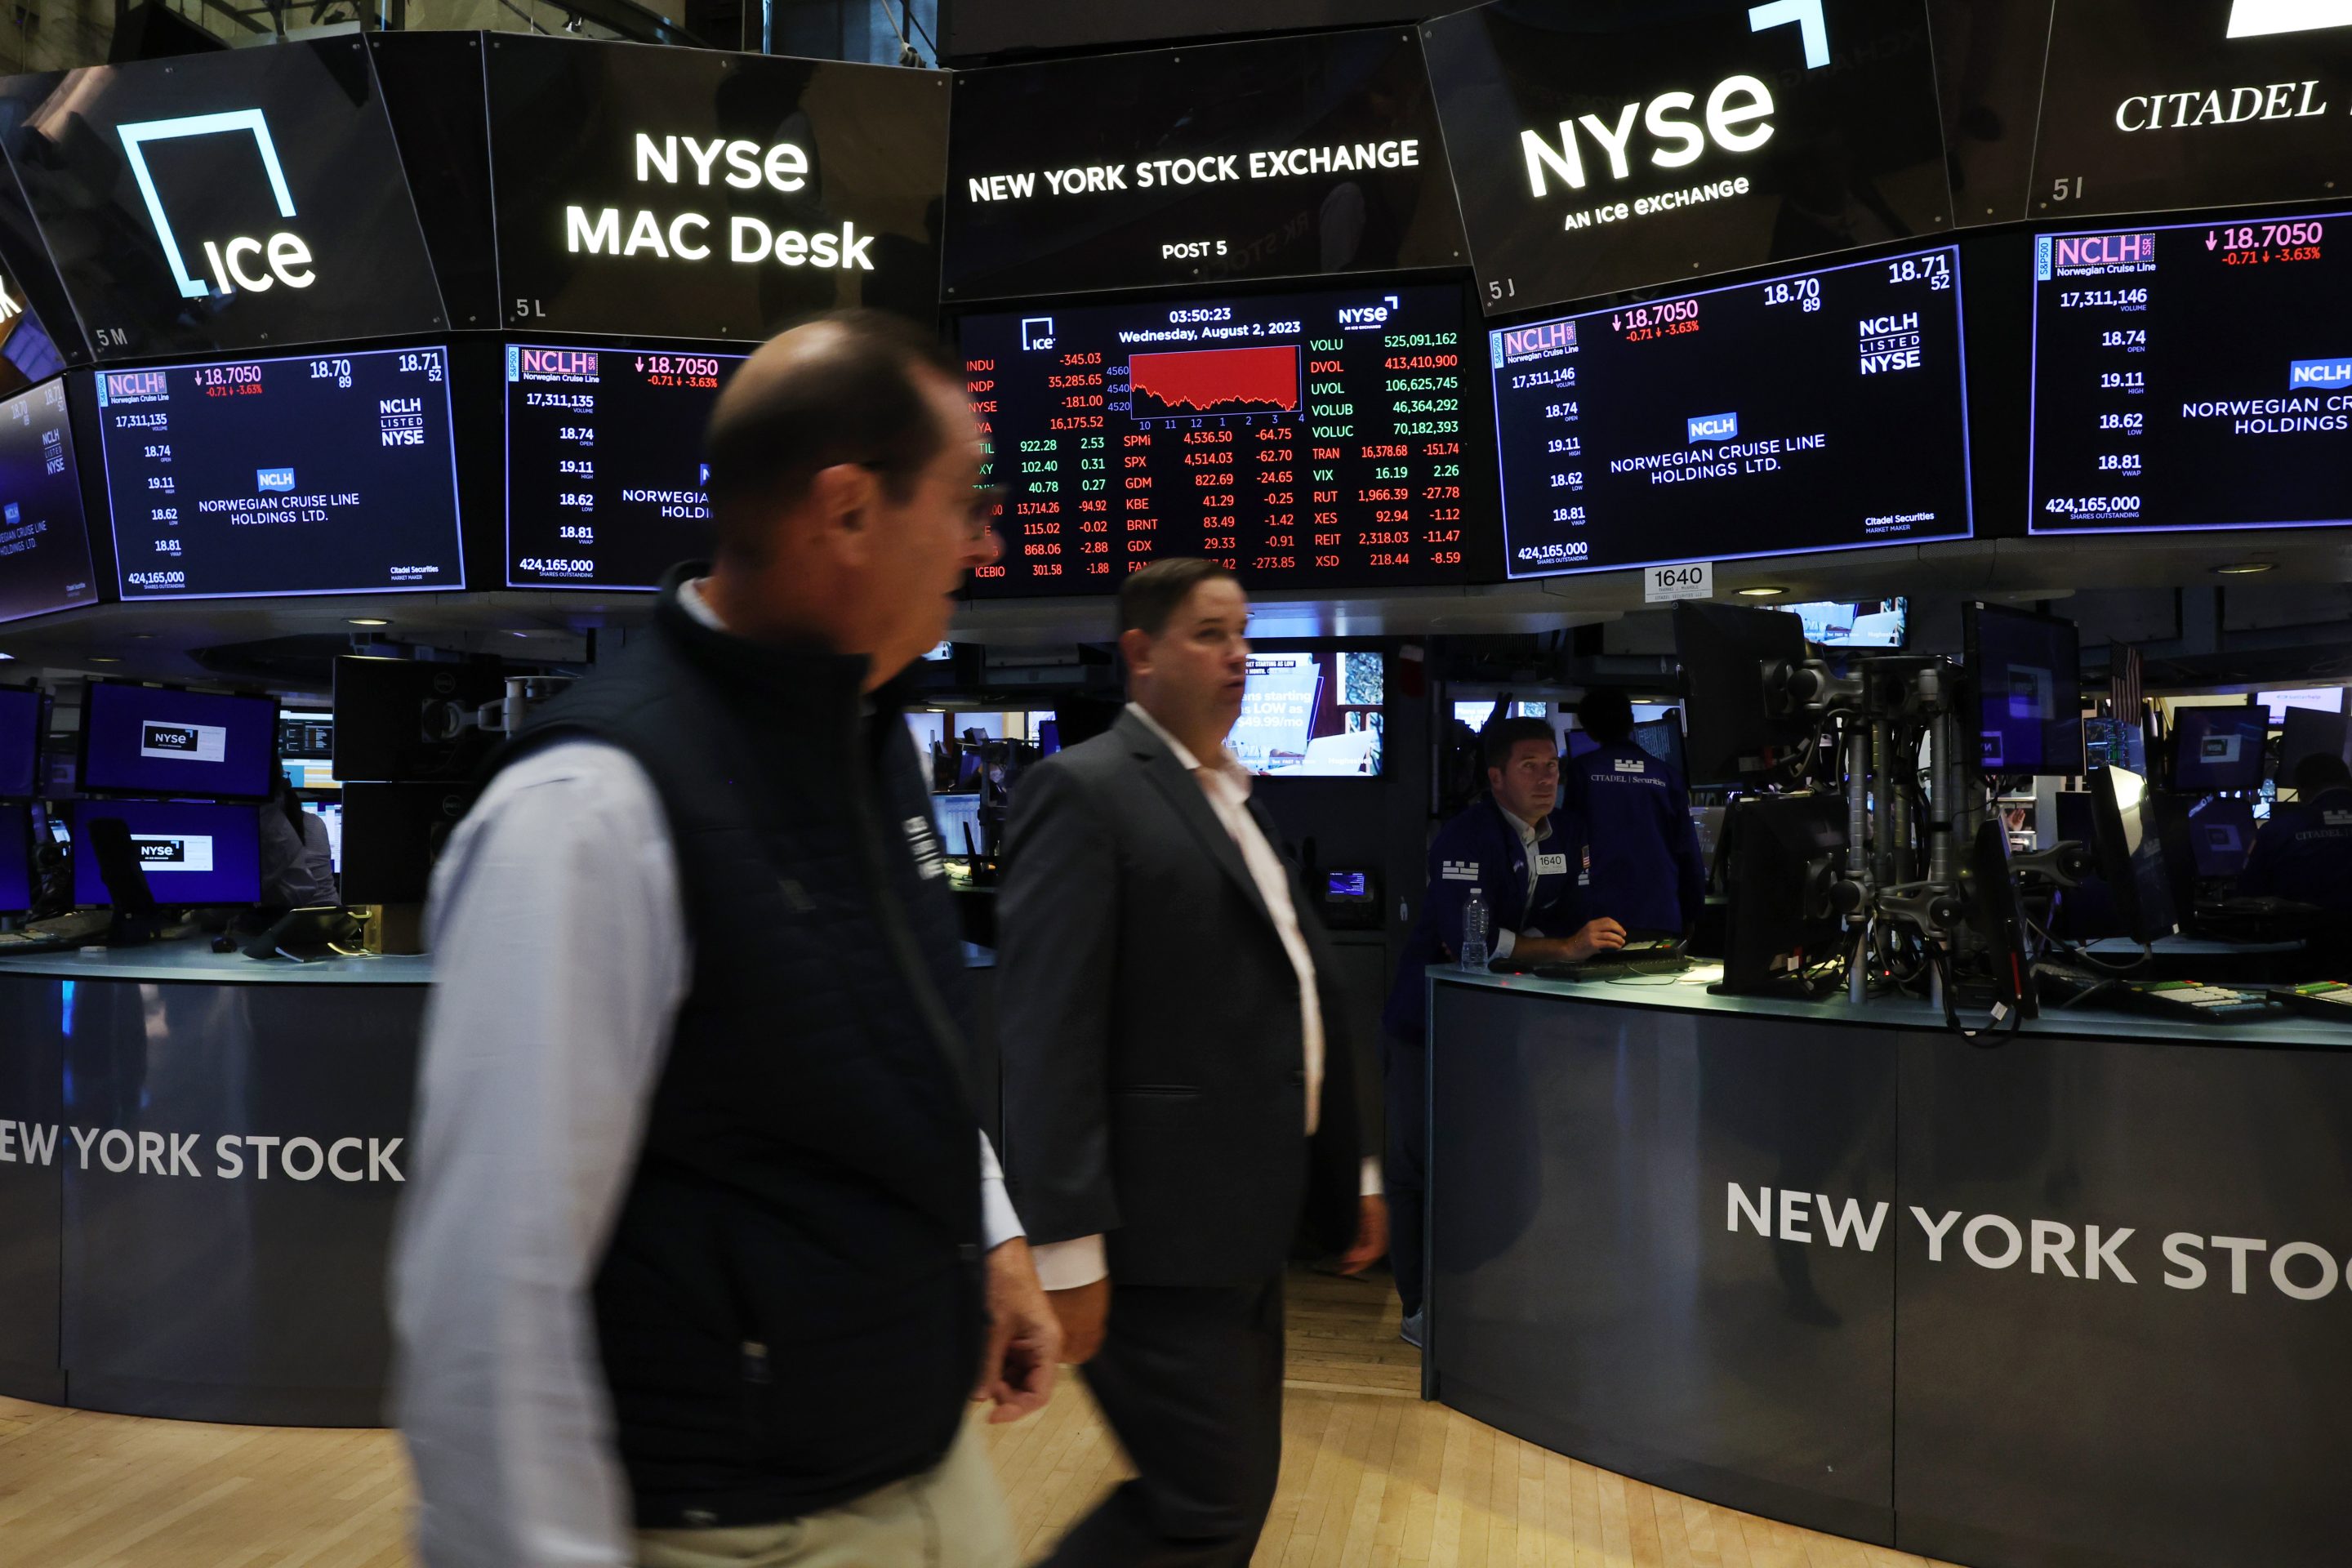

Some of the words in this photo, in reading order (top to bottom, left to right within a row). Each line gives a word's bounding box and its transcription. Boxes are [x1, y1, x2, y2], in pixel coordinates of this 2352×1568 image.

[2116, 81, 2327, 131] CITADEL
[969, 173, 1035, 202] NEW
[1044, 165, 1127, 194] YORK
[1137, 155, 1240, 187] STOCK
[1250, 140, 1419, 178] EXCHANGE
[2053, 178, 2069, 200] 5
[1565, 212, 1591, 230] AN
[567, 206, 710, 260] MAC
[731, 216, 875, 270] Desk
[2224, 222, 2322, 250] 18.7050
[1163, 242, 1210, 259] POST
[1217, 241, 1227, 255] 5
[2059, 234, 2141, 266] NCLH
[2222, 252, 2257, 265] -0.71
[2275, 247, 2320, 261] -3.63%
[1888, 256, 1950, 283] 18.71
[2057, 265, 2105, 276] Norwegian
[2107, 265, 2135, 274] Cruise
[2137, 263, 2156, 271] Line
[1490, 281, 1502, 299] 5
[1508, 278, 1514, 296] J
[1931, 274, 1949, 290] 52
[1764, 278, 1821, 305] 18.70
[2060, 288, 2147, 308] 17,311,146
[517, 299, 528, 316] 5
[536, 300, 546, 317] L
[1625, 300, 1699, 328] 18.7050
[1803, 298, 1821, 312] 89
[1169, 308, 1231, 323] 03:50:23
[1860, 312, 1918, 336] NCLH
[96, 330, 109, 345] 5
[110, 328, 127, 345] M
[1119, 328, 1197, 343] Wednesday,
[1201, 325, 1249, 339] August
[1253, 323, 1264, 336] 2,
[1268, 321, 1300, 334] 2023
[1627, 328, 1653, 341] -0.71
[1665, 320, 1699, 335] -3.63%
[2102, 330, 2146, 345] 18.74
[1310, 339, 1343, 351] VOLU
[1385, 332, 1456, 347] 525,091,162
[1507, 323, 1566, 357] NCLH
[1860, 334, 1920, 354] LISTED
[310, 359, 352, 378] 18.70
[399, 353, 441, 372] 18.71
[522, 350, 589, 374] NCLH
[648, 357, 718, 376] 18.7050
[967, 359, 994, 371] INDU
[1060, 353, 1101, 365] -345.03
[1311, 361, 1343, 372] DVOL
[1385, 354, 1457, 369] 413,410,900
[1860, 350, 1921, 374] NYSE
[205, 366, 261, 385] 18.7050
[1512, 368, 1575, 389] 17,311,146
[2101, 372, 2145, 387] 19.11
[2294, 365, 2352, 382] NCLH
[109, 372, 160, 395] NCLH
[968, 381, 994, 392] INDP
[1049, 374, 1102, 388] 35,285.65
[1312, 382, 1344, 394] UVOL
[1386, 377, 1458, 391] 106,625,745
[380, 398, 421, 413] NCLH
[527, 393, 594, 408] 17,311,135
[2183, 398, 2319, 417] NORWEGIAN
[1546, 402, 1578, 418] 18.74
[116, 413, 167, 428] 17,311,135
[381, 417, 422, 427] LISTED
[1051, 416, 1103, 430] 16,175.52
[1312, 425, 1353, 438] VOLUC
[1394, 421, 1458, 435] 70,182,393
[1688, 418, 1734, 435] NCLH
[2235, 415, 2348, 434] HOLDINGS
[382, 430, 424, 446] NYSE
[560, 428, 594, 439] 18.74
[1124, 434, 1151, 447] SPMi
[1184, 431, 1232, 444] 4,536.50
[1255, 428, 1292, 440] -64.75
[145, 445, 171, 457] 18.74
[1021, 439, 1057, 452] 922.28
[1081, 437, 1104, 448] 2.53
[1312, 448, 1339, 459] TRAN
[1362, 445, 1408, 458] 16,378.68
[1423, 443, 1459, 455] -151.74
[1548, 437, 1580, 452] 19.11
[1611, 448, 1715, 474] NORWEGIAN
[1719, 440, 1780, 459] CRUISE
[1786, 434, 1825, 451] LINE
[560, 461, 594, 473] 19.11
[1022, 461, 1058, 472] 102.40
[1081, 458, 1105, 470] 0.31
[1313, 470, 1333, 481] VIX
[1376, 467, 1407, 479] 16.19
[1434, 465, 1459, 476] 2.26
[1651, 461, 1737, 484] HOLDINGS
[1746, 458, 1780, 473] LTD.
[257, 474, 295, 487] NCLH
[1551, 472, 1583, 487] 18.62
[199, 497, 278, 512] NORWEGIAN
[282, 495, 327, 508] CRUISE
[331, 493, 359, 506] LINE
[623, 490, 708, 503] NORWEGIA
[1314, 491, 1338, 502] RUT
[1359, 488, 1408, 501] 1,966.39
[1423, 487, 1459, 498] -27.78
[2046, 497, 2140, 513] 424,165,000
[231, 511, 296, 525] HOLDINGS
[302, 510, 328, 522] LTD.
[1865, 515, 1894, 525] Citadel
[1895, 512, 1935, 523] Securities
[1316, 555, 1339, 566] XSD
[1370, 554, 1409, 565] 218.44
[1431, 552, 1460, 564] -8.59
[1518, 541, 1588, 560] 424,165,000
[1033, 564, 1062, 575] 301.58
[1087, 563, 1109, 573] -1.88
[1655, 568, 1702, 586] 1640
[1263, 690, 1312, 702] starting
[1254, 704, 1286, 713] LOW
[1289, 705, 1303, 713] as
[1633, 777, 1665, 786] Securities
[2295, 829, 2343, 841] CITADEL
[1540, 856, 1561, 865] 1640
[69, 1126, 201, 1177] YORK
[216, 1134, 405, 1181] STOCK
[1727, 1183, 1889, 1251] NEW
[1909, 1206, 2137, 1284] YORK
[2163, 1232, 2352, 1300] STO
